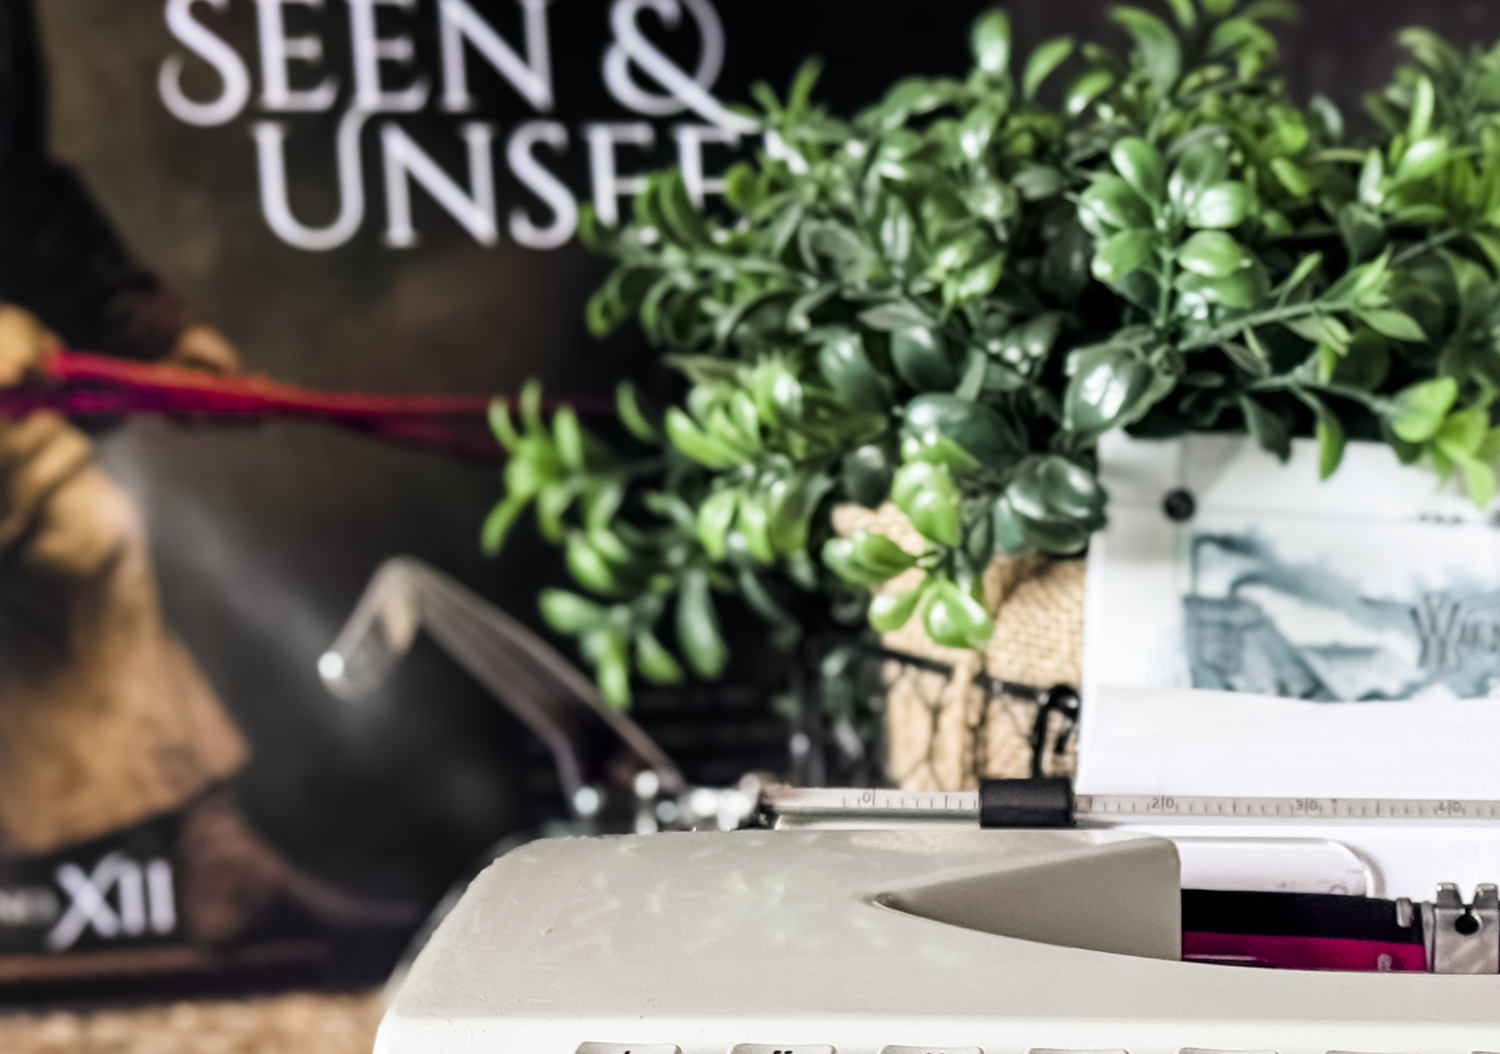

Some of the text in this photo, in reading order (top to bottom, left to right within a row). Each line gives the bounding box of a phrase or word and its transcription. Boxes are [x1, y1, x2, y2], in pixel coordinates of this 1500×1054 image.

[157, 0, 758, 130] SEEN &
[252, 104, 790, 251] UNSEE
[1151, 797, 1175, 810] 20
[48, 852, 177, 951] XII
